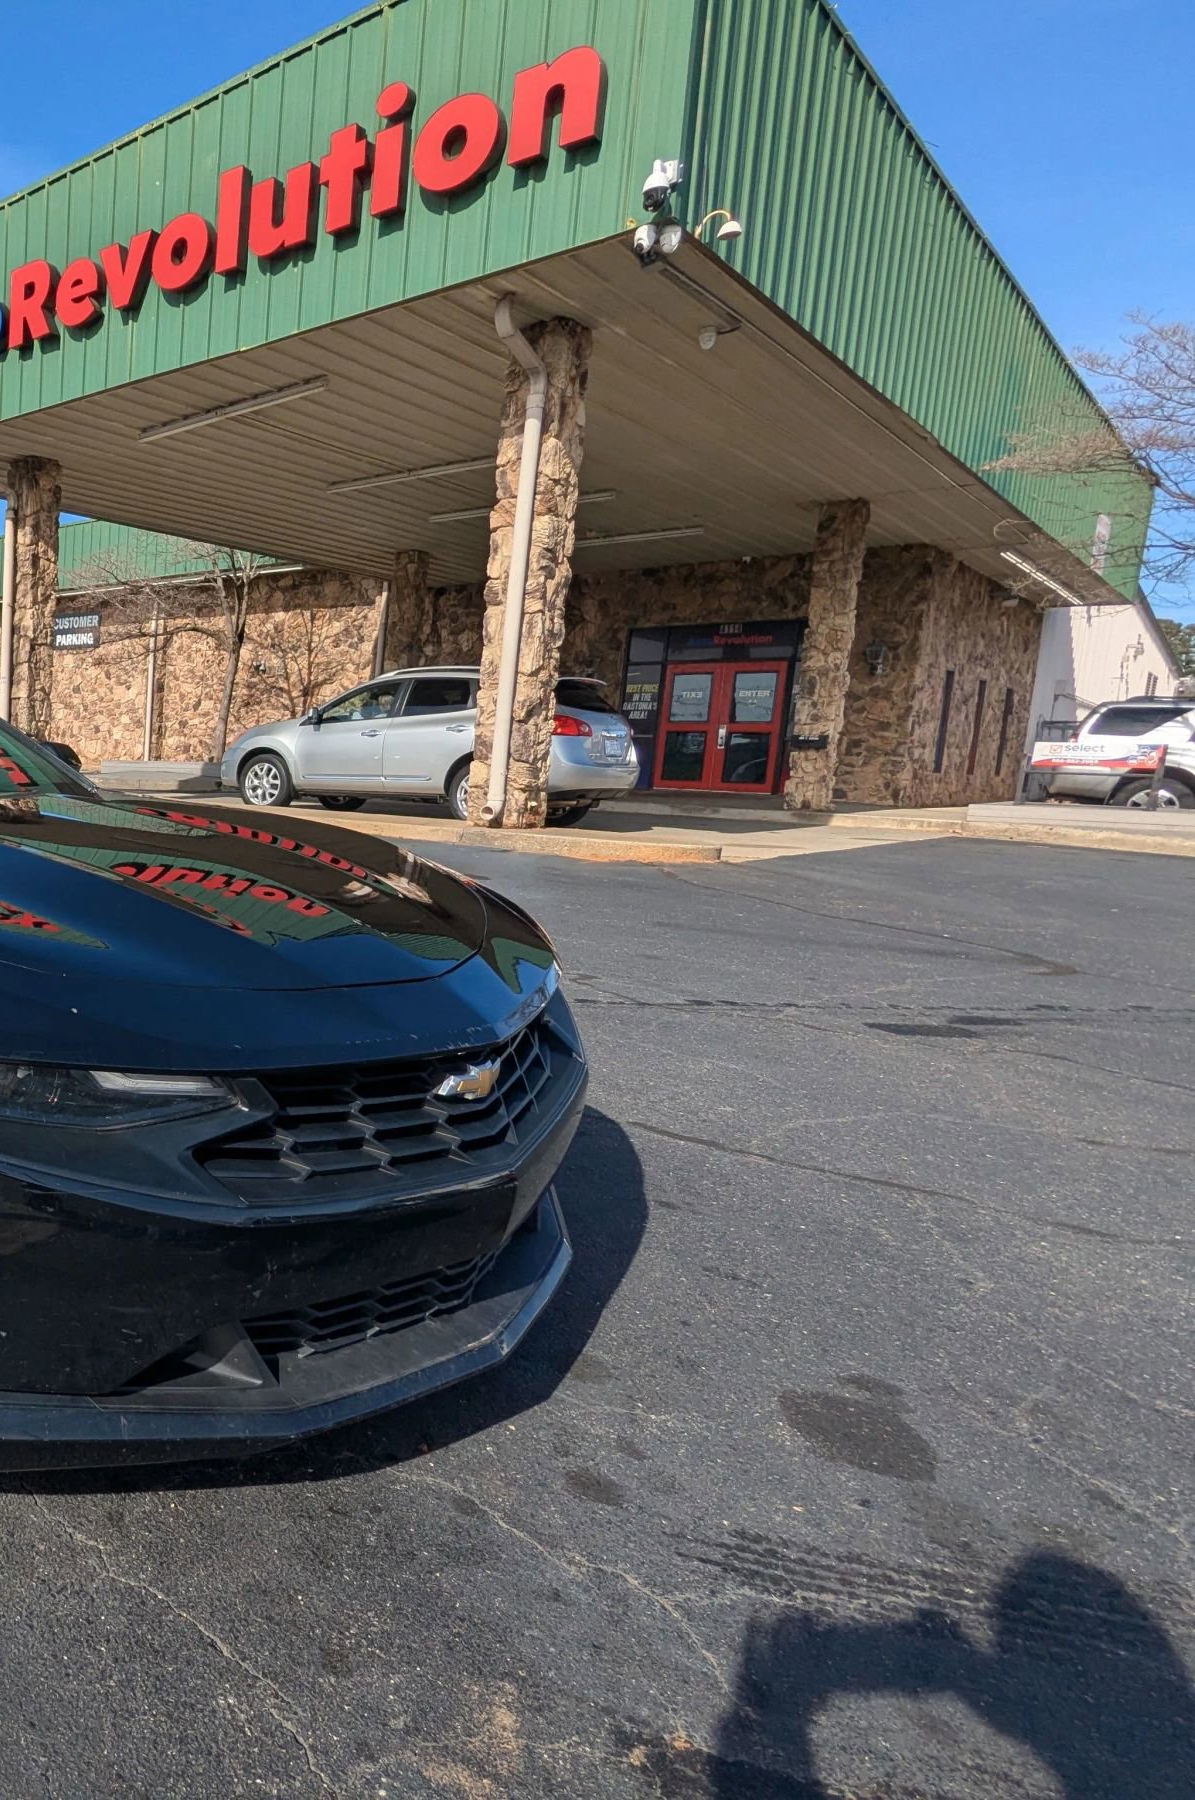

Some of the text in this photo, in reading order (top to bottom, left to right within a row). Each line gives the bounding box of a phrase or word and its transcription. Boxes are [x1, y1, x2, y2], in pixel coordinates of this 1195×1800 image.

[53, 615, 99, 629] CUSTOMER
[56, 633, 94, 646] PARKING
[641, 693, 652, 701] THE
[628, 711, 648, 719] AREA!
[1064, 744, 1106, 753] select
